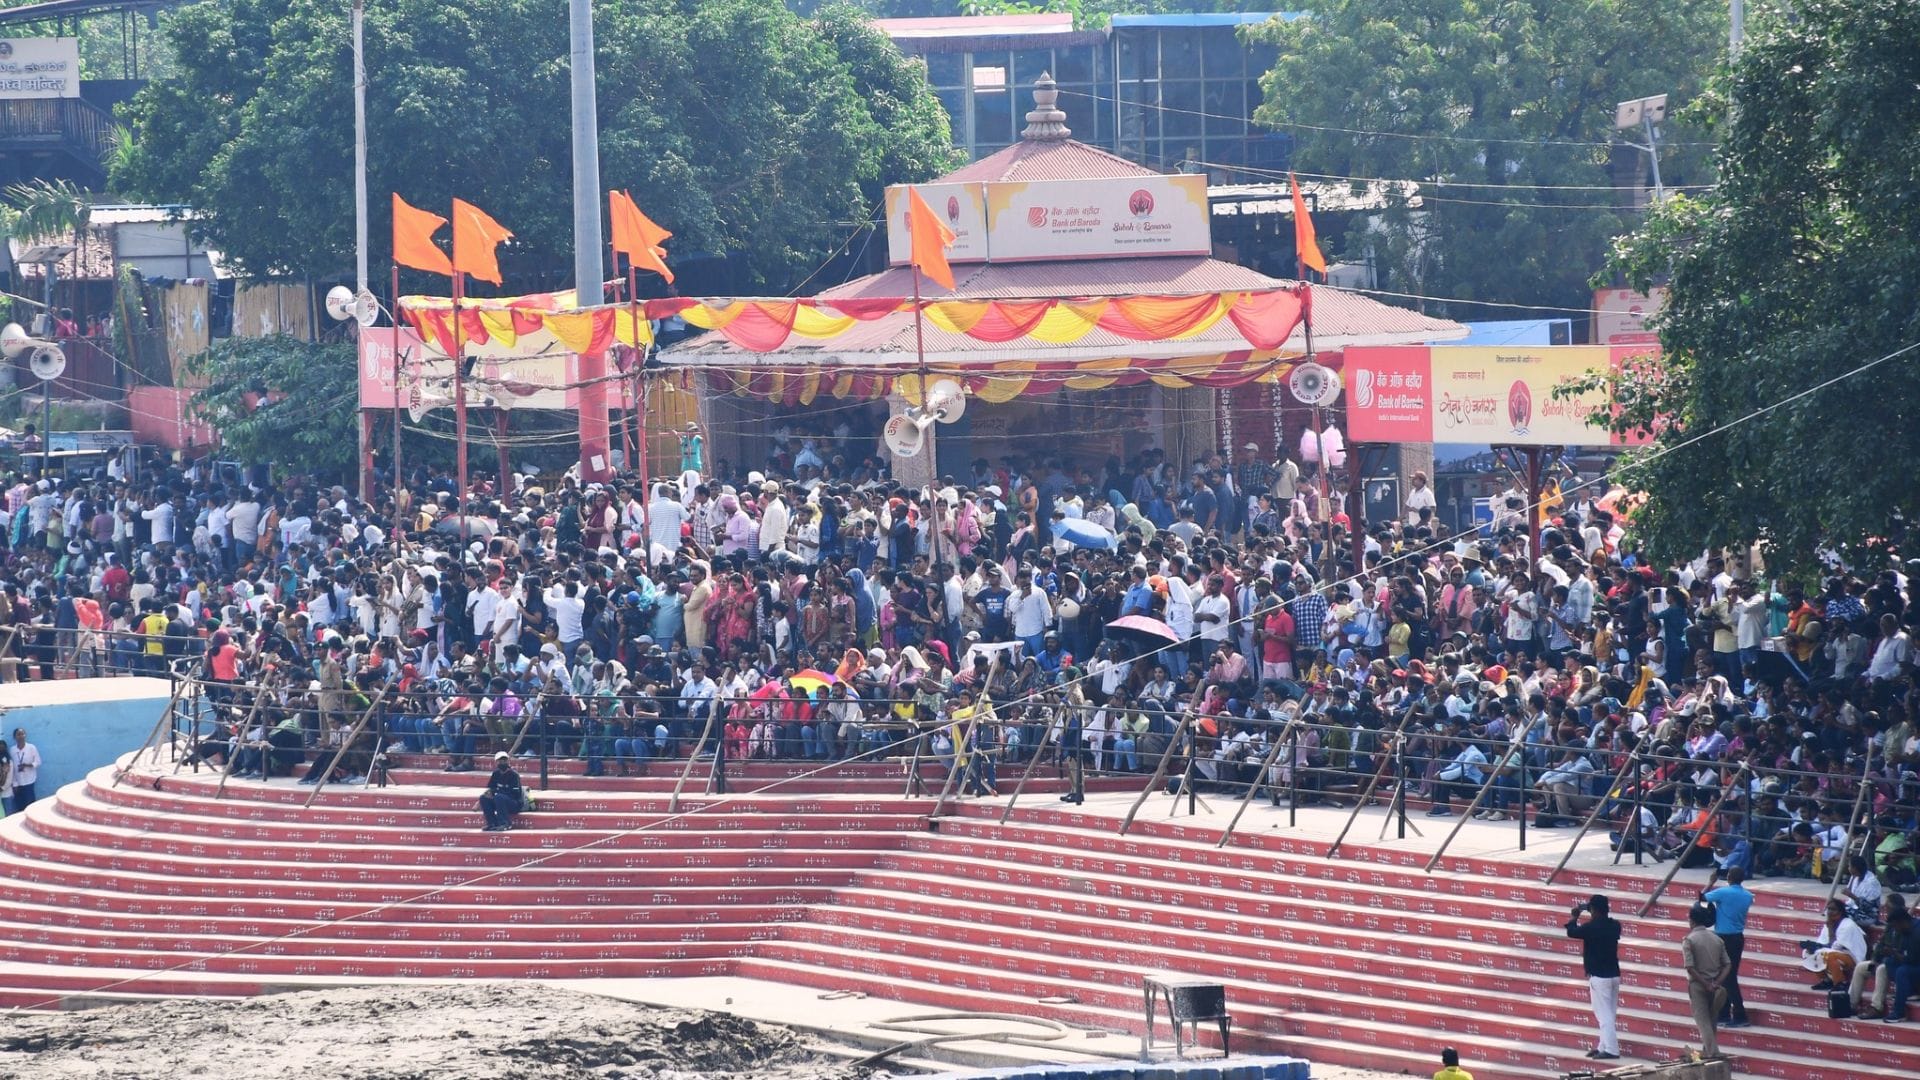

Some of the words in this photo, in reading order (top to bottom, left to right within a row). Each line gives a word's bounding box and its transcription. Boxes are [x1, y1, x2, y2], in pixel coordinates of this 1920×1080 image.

[1052, 219, 1069, 228] Bank
[1069, 219, 1077, 228] of
[1077, 217, 1101, 227] Baroda
[1378, 394, 1394, 409] Bank
[1394, 394, 1401, 409] of
[1401, 394, 1424, 409] Baroda
